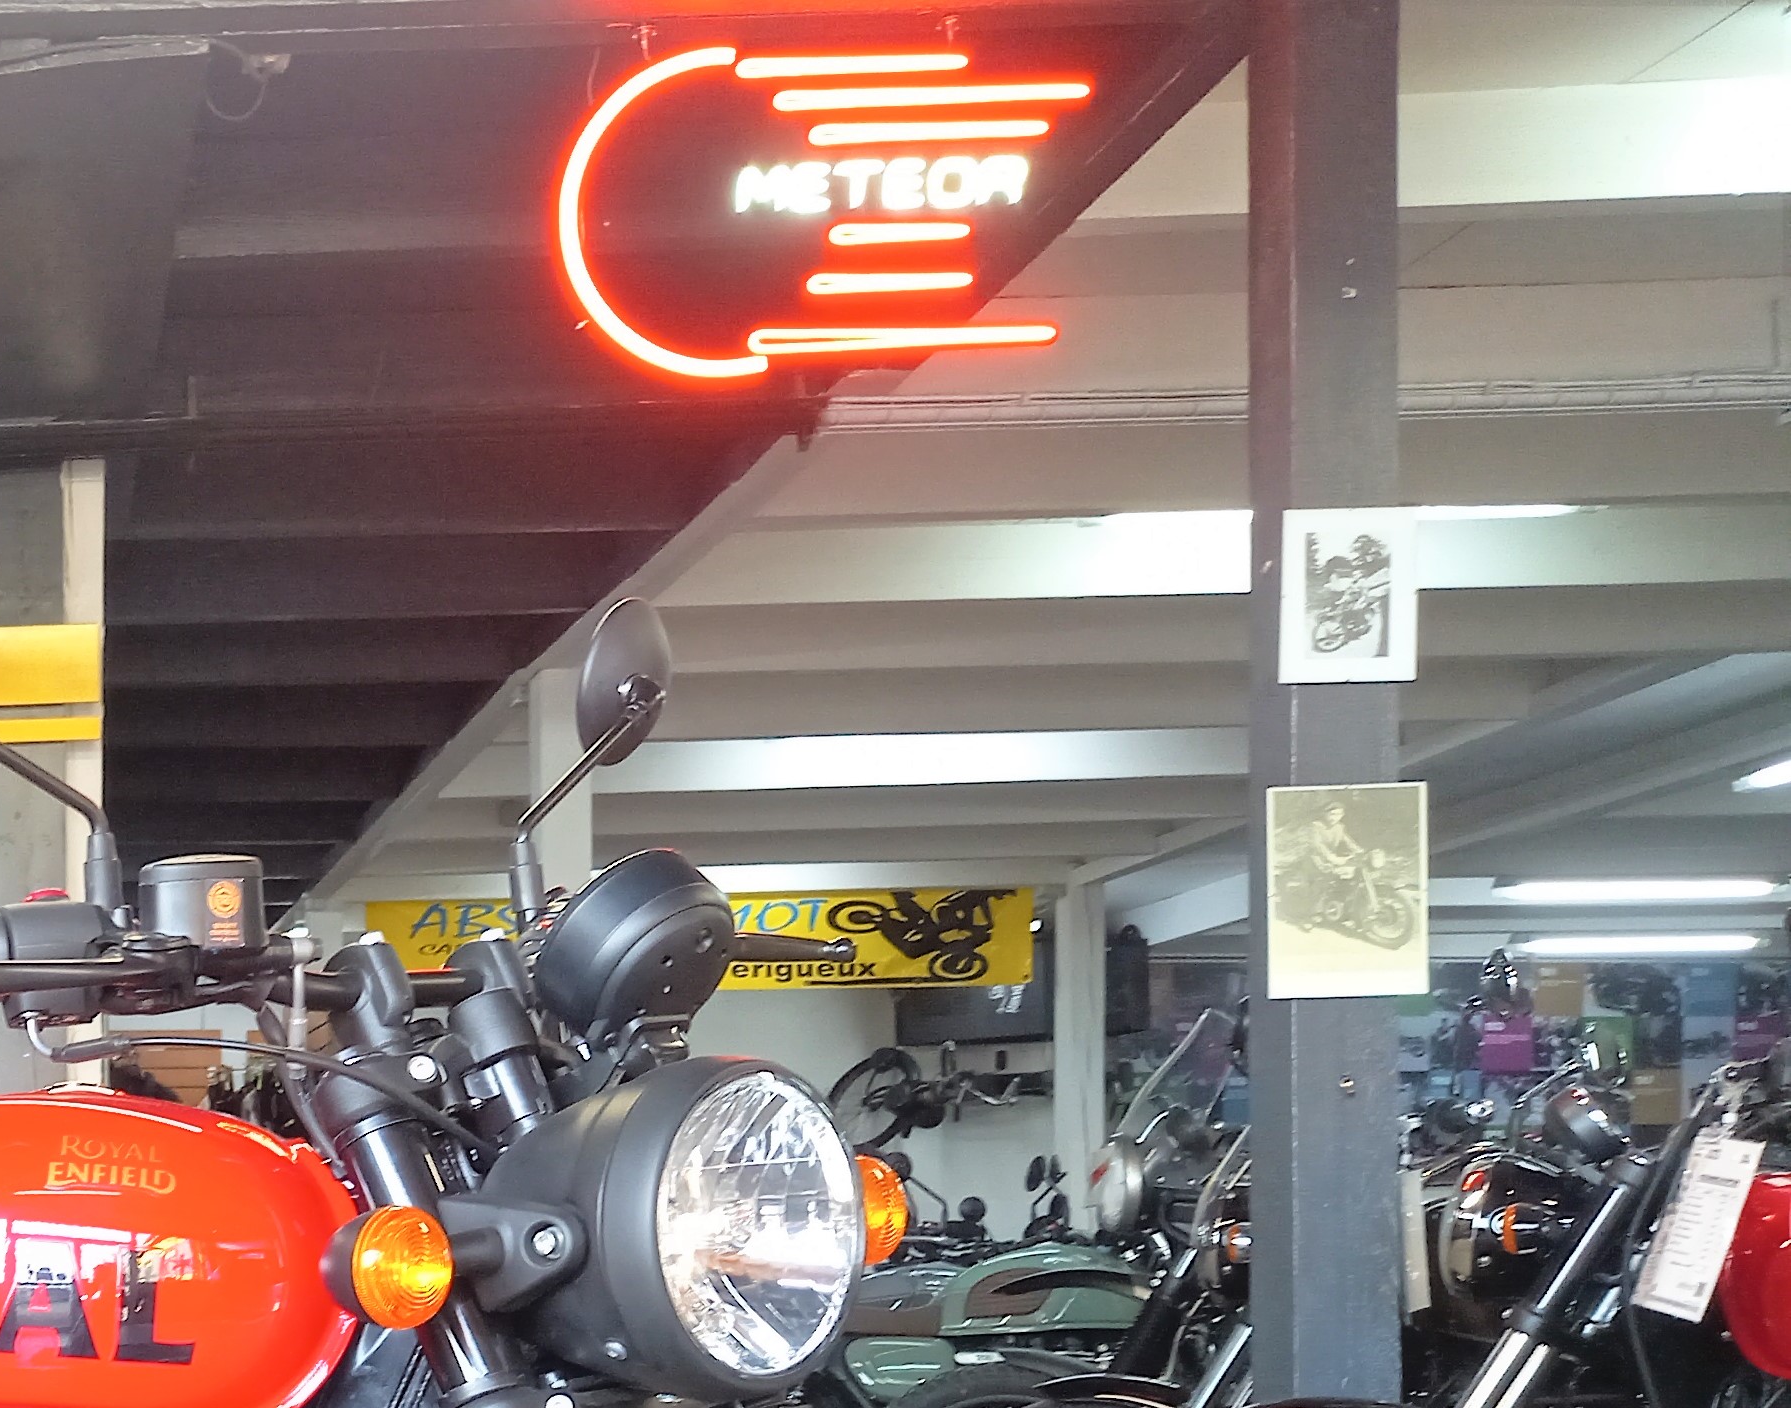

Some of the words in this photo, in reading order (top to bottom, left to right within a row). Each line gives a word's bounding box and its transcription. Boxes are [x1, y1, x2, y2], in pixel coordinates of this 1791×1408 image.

[734, 154, 1030, 214] METEOR
[731, 962, 877, 982] erigueux
[61, 1135, 163, 1162] ROYAL
[47, 1162, 177, 1195] ENFIELD
